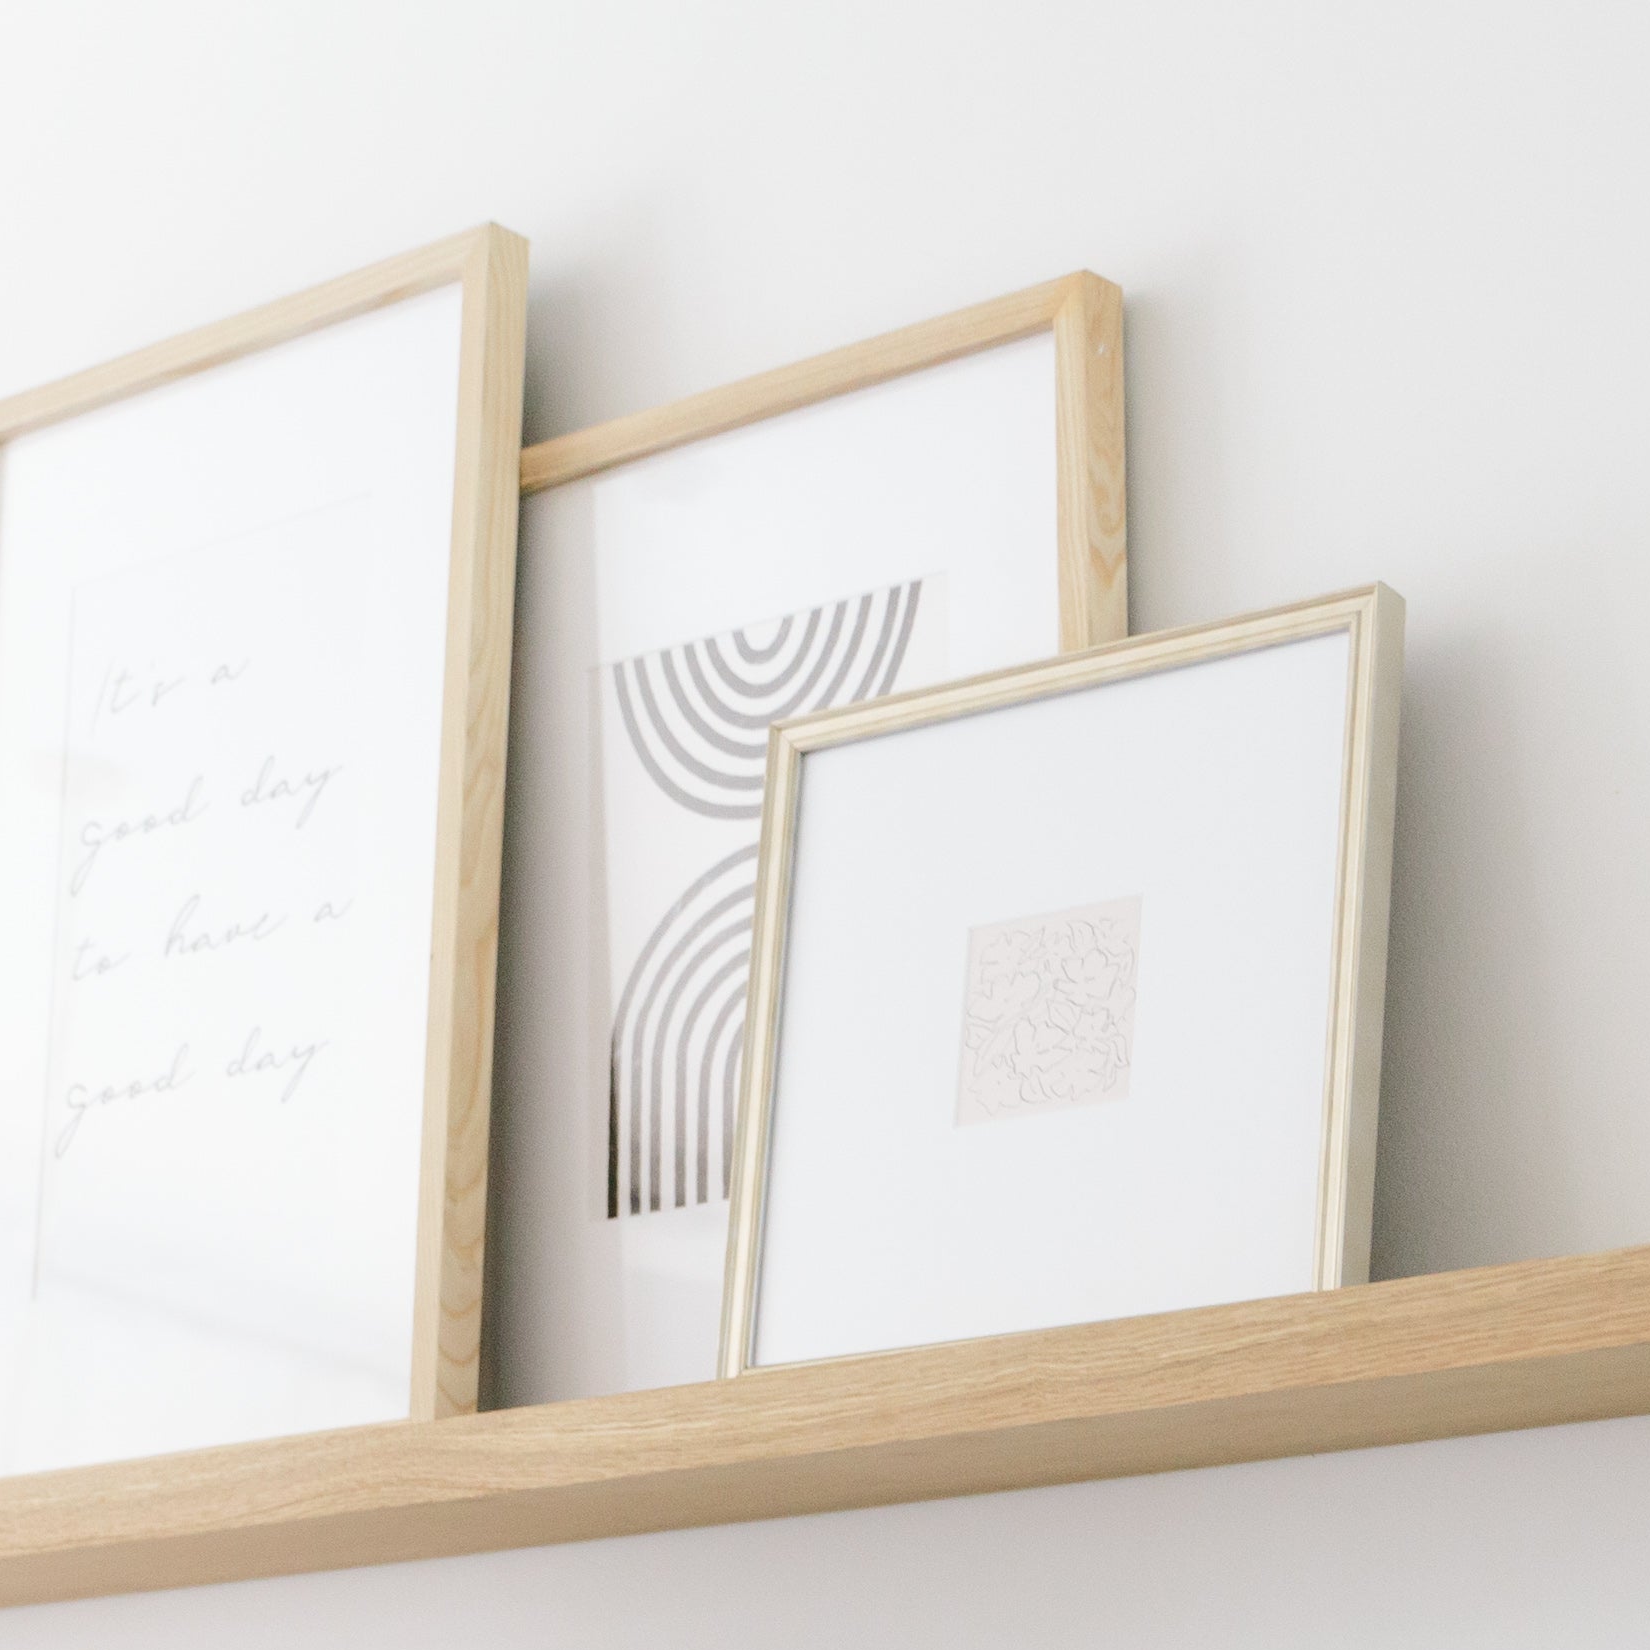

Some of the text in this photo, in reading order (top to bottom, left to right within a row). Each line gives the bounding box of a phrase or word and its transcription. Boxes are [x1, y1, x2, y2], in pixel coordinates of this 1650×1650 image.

[88, 656, 252, 741] It's a
[71, 754, 345, 898] good day
[71, 892, 355, 983] to have a
[54, 1025, 332, 1161] good day
